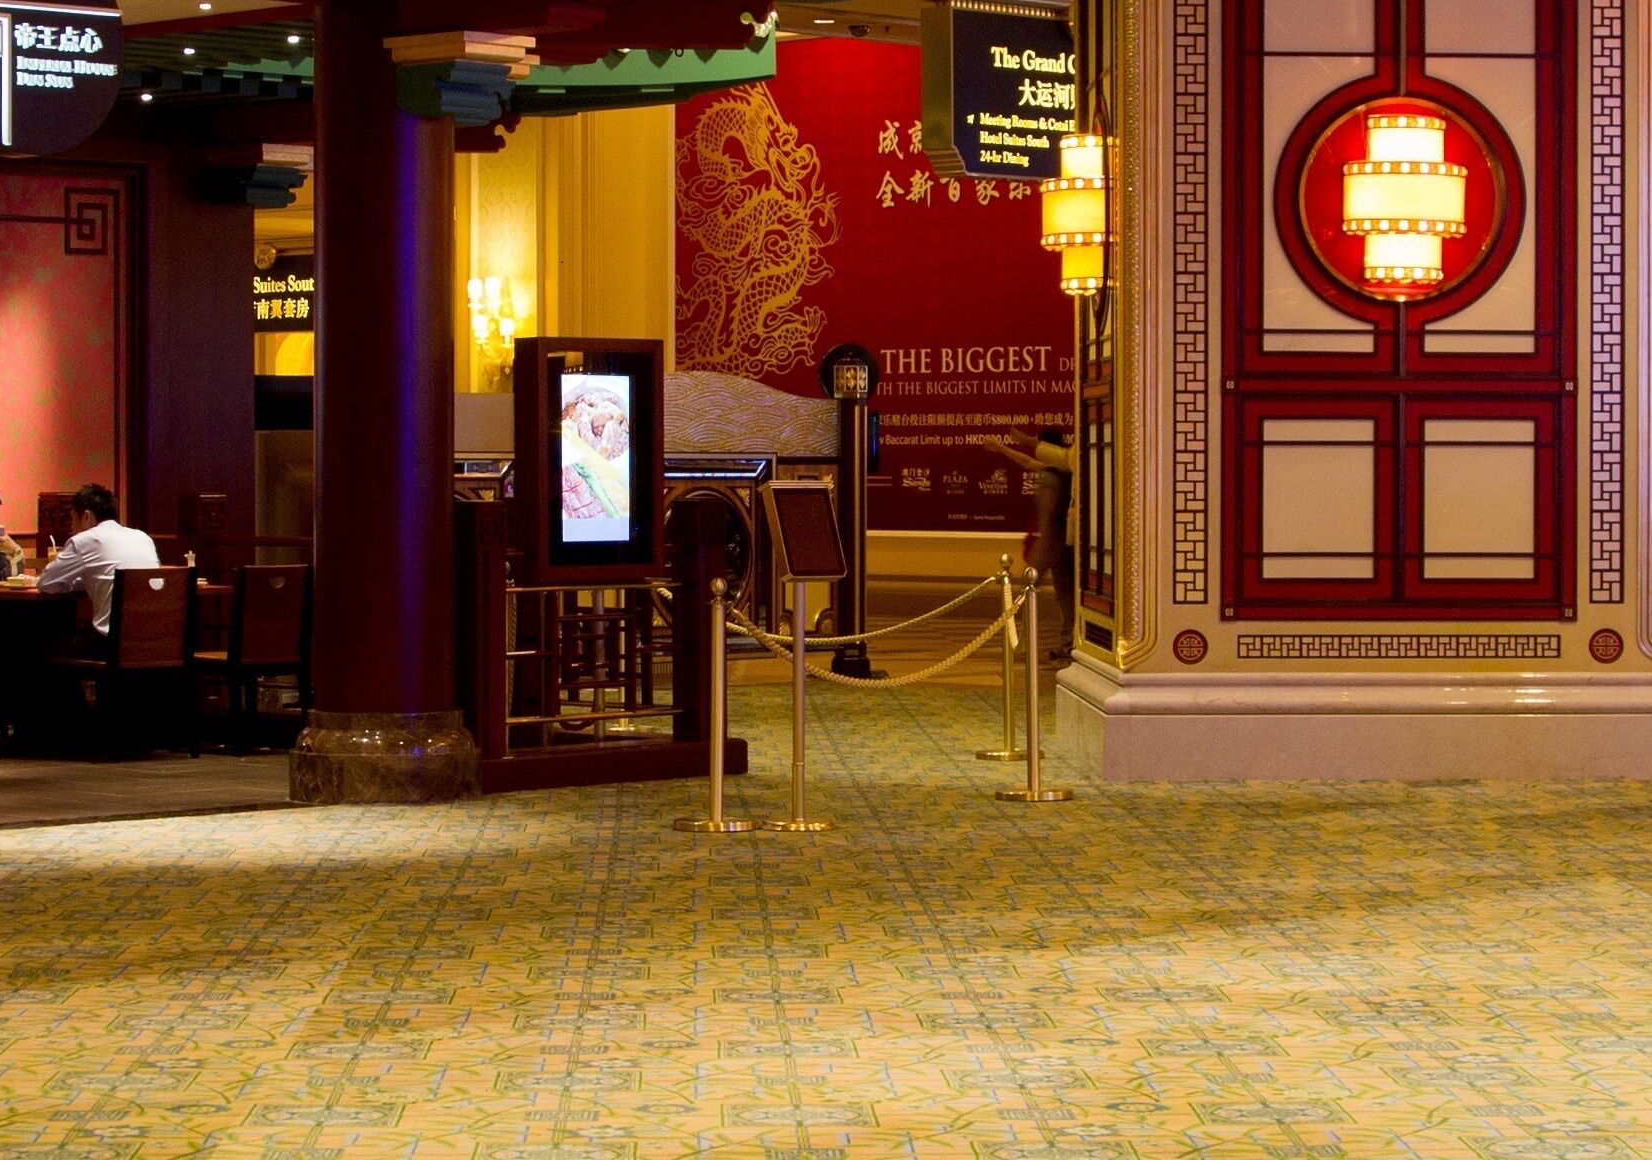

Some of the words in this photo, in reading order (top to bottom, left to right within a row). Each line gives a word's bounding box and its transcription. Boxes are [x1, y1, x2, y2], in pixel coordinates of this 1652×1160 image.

[14, 22, 103, 53] 帝王点心
[991, 46, 1020, 69] The
[1022, 49, 1066, 74] Grand
[979, 112, 1011, 129] Meeting
[1011, 114, 1038, 129] Rooms
[1039, 116, 1048, 130] &
[979, 130, 1002, 145] Hotel
[1003, 132, 1026, 147] Suites
[1027, 134, 1050, 148] South
[1002, 151, 1029, 167] Dining
[253, 276, 287, 294] Suites
[287, 274, 315, 292] Sout
[253, 297, 310, 320] 南翼套房
[880, 348, 932, 374] THE
[940, 346, 1052, 373] BIGGEST
[877, 381, 893, 395] TH
[896, 381, 922, 395] THE
[926, 380, 979, 395] BIGGEST
[983, 380, 1027, 394] LIMITS
[1031, 380, 1047, 393] IN
[885, 434, 920, 445] Baccarat
[920, 434, 941, 445] Limit
[942, 436, 954, 447] up
[955, 435, 964, 445] to
